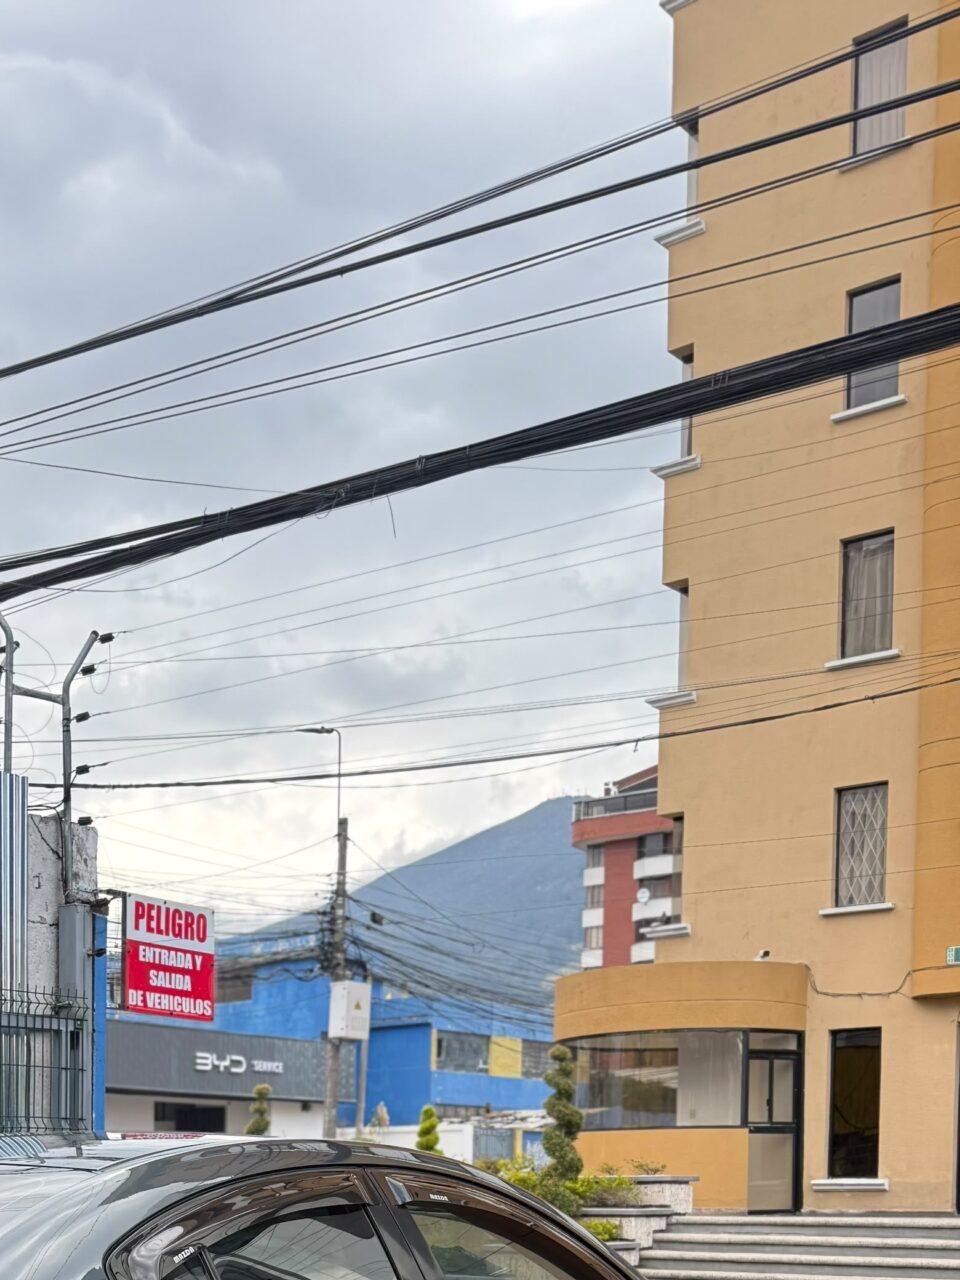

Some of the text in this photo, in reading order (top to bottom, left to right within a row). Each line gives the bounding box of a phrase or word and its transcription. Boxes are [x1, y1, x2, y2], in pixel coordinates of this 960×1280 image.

[134, 901, 207, 943] PELIGRO
[139, 945, 203, 971] ENTRADA Y
[149, 970, 191, 991] SALIDA
[128, 990, 212, 1016] DE VEHICULOS
[195, 1052, 247, 1073] BYD
